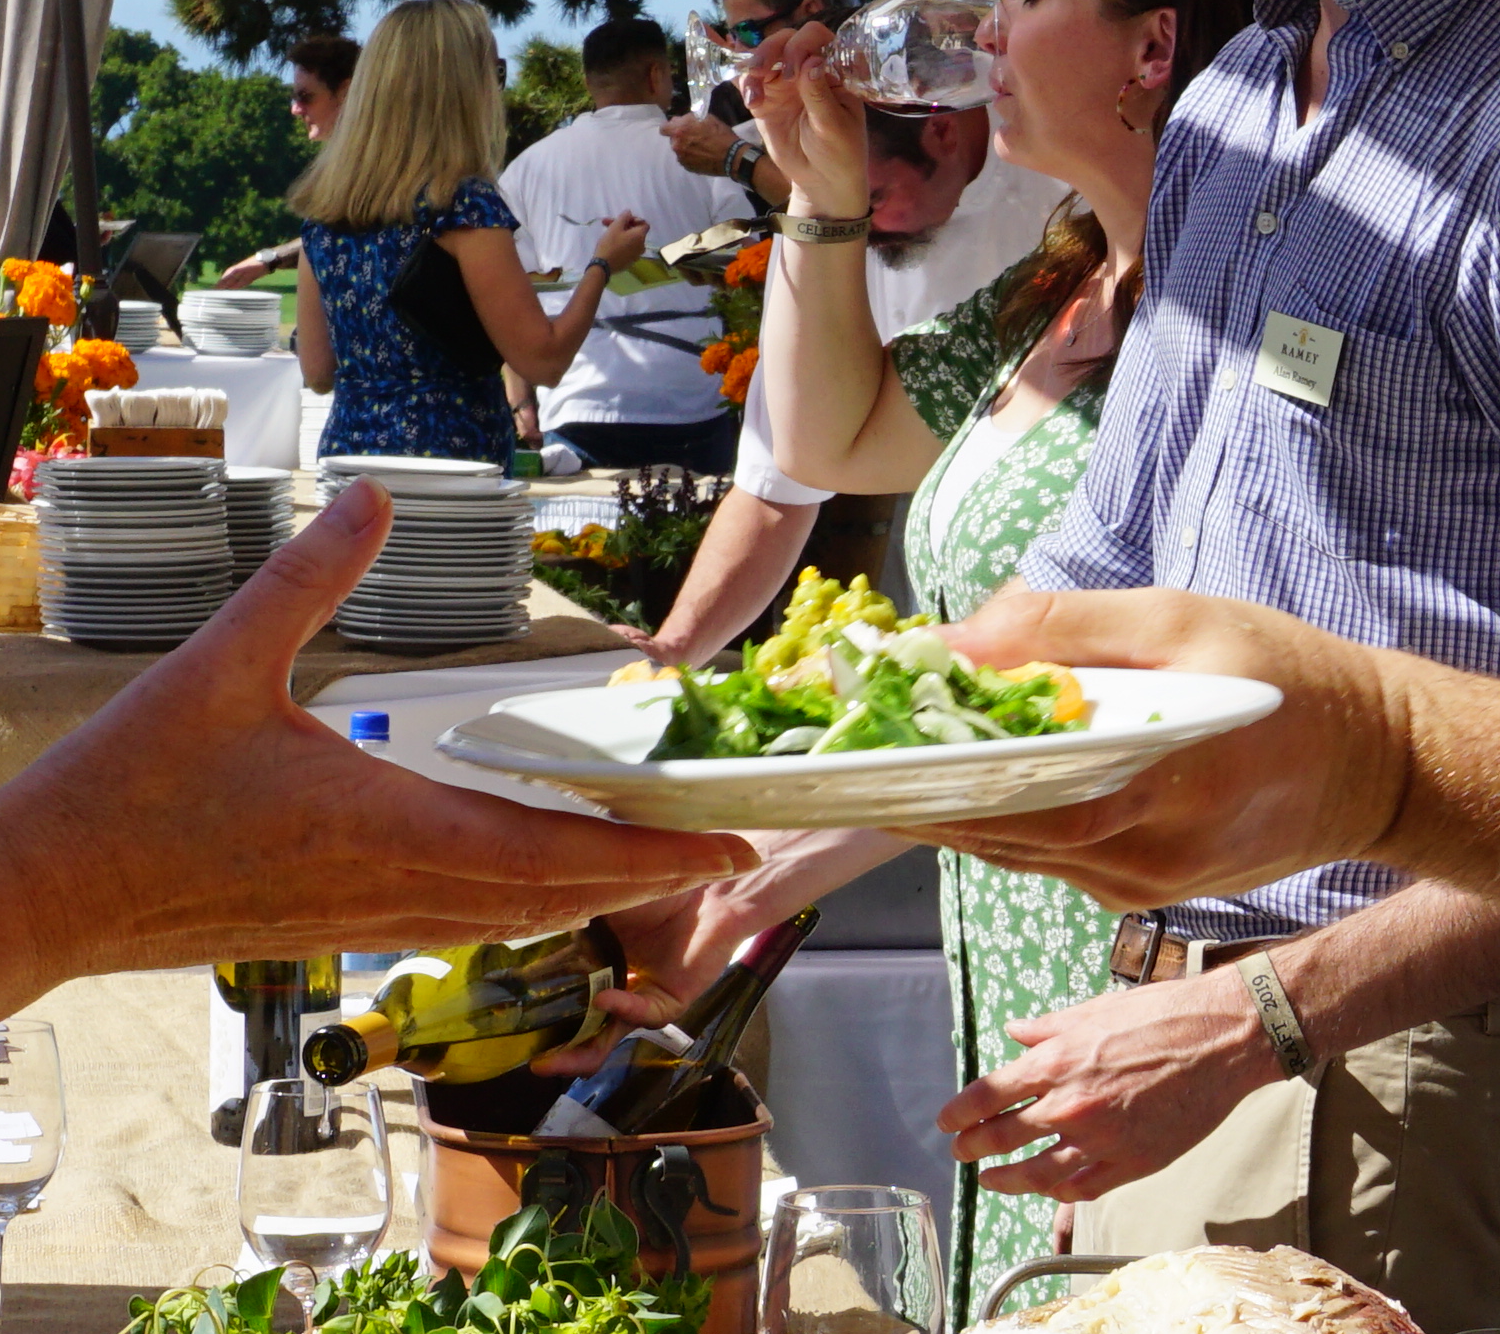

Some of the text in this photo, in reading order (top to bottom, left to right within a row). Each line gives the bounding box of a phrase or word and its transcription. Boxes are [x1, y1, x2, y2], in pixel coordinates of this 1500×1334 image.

[1281, 343, 1319, 365] RAMEY
[1252, 974, 1308, 1075] CRAFT 2019
